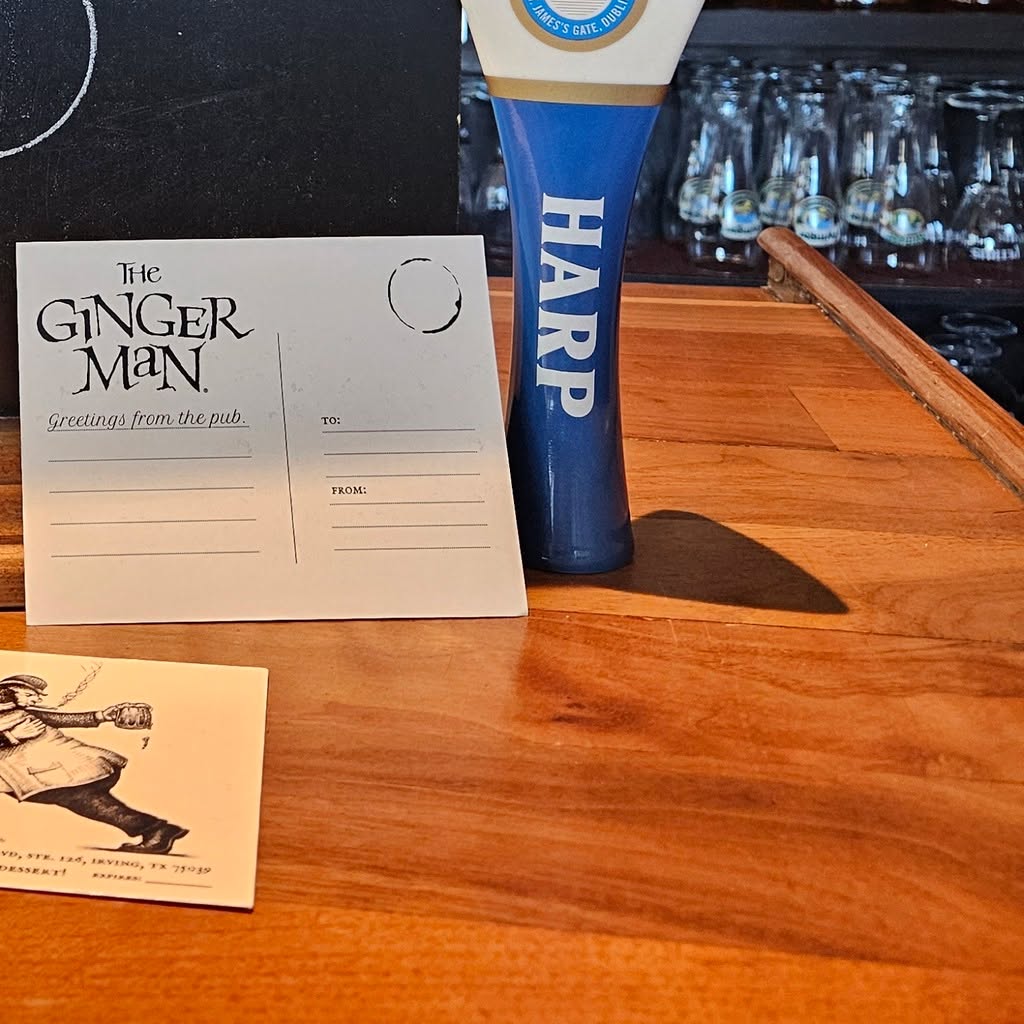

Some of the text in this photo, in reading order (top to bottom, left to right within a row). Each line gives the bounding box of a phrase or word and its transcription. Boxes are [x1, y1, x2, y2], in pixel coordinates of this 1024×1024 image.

[532, 4, 570, 34] JAMES'S
[572, 22, 604, 36] GATE,
[536, 192, 605, 418] HARP
[47, 409, 246, 432] Greetings from the pub.
[320, 416, 341, 425] TO:
[331, 485, 367, 495] FROM:
[91, 857, 145, 871] IRVING,
[150, 862, 168, 871] TX
